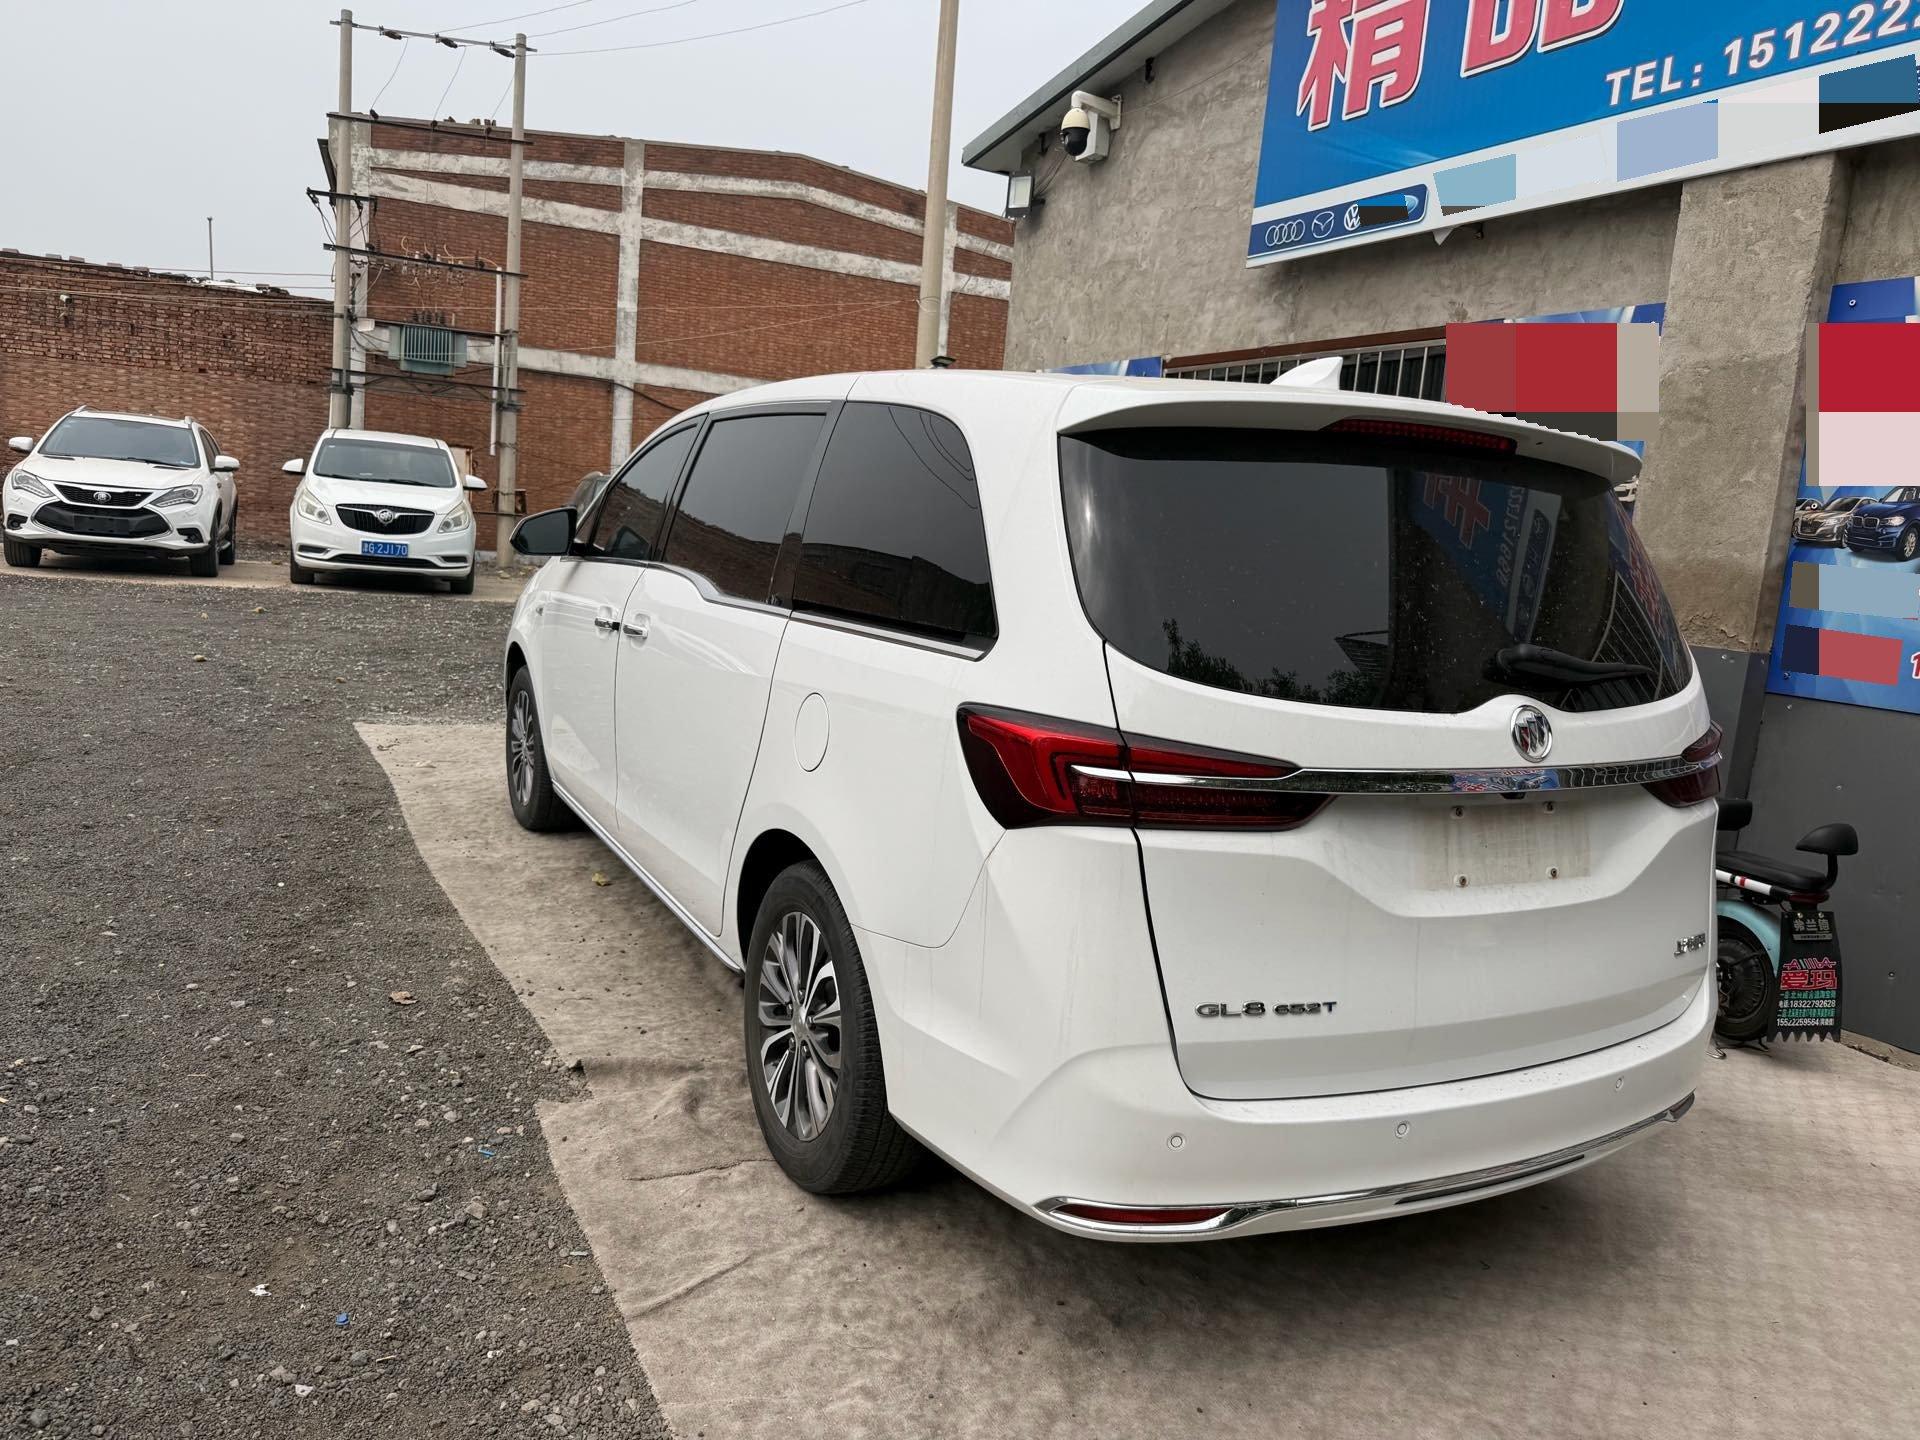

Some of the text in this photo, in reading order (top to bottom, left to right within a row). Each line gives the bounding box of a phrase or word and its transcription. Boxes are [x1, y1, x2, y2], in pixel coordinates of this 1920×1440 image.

[1723, 0, 1920, 76] 151222
[1780, 970, 1838, 990] 爱玛
[1195, 1001, 1337, 1018] GL8 652T
